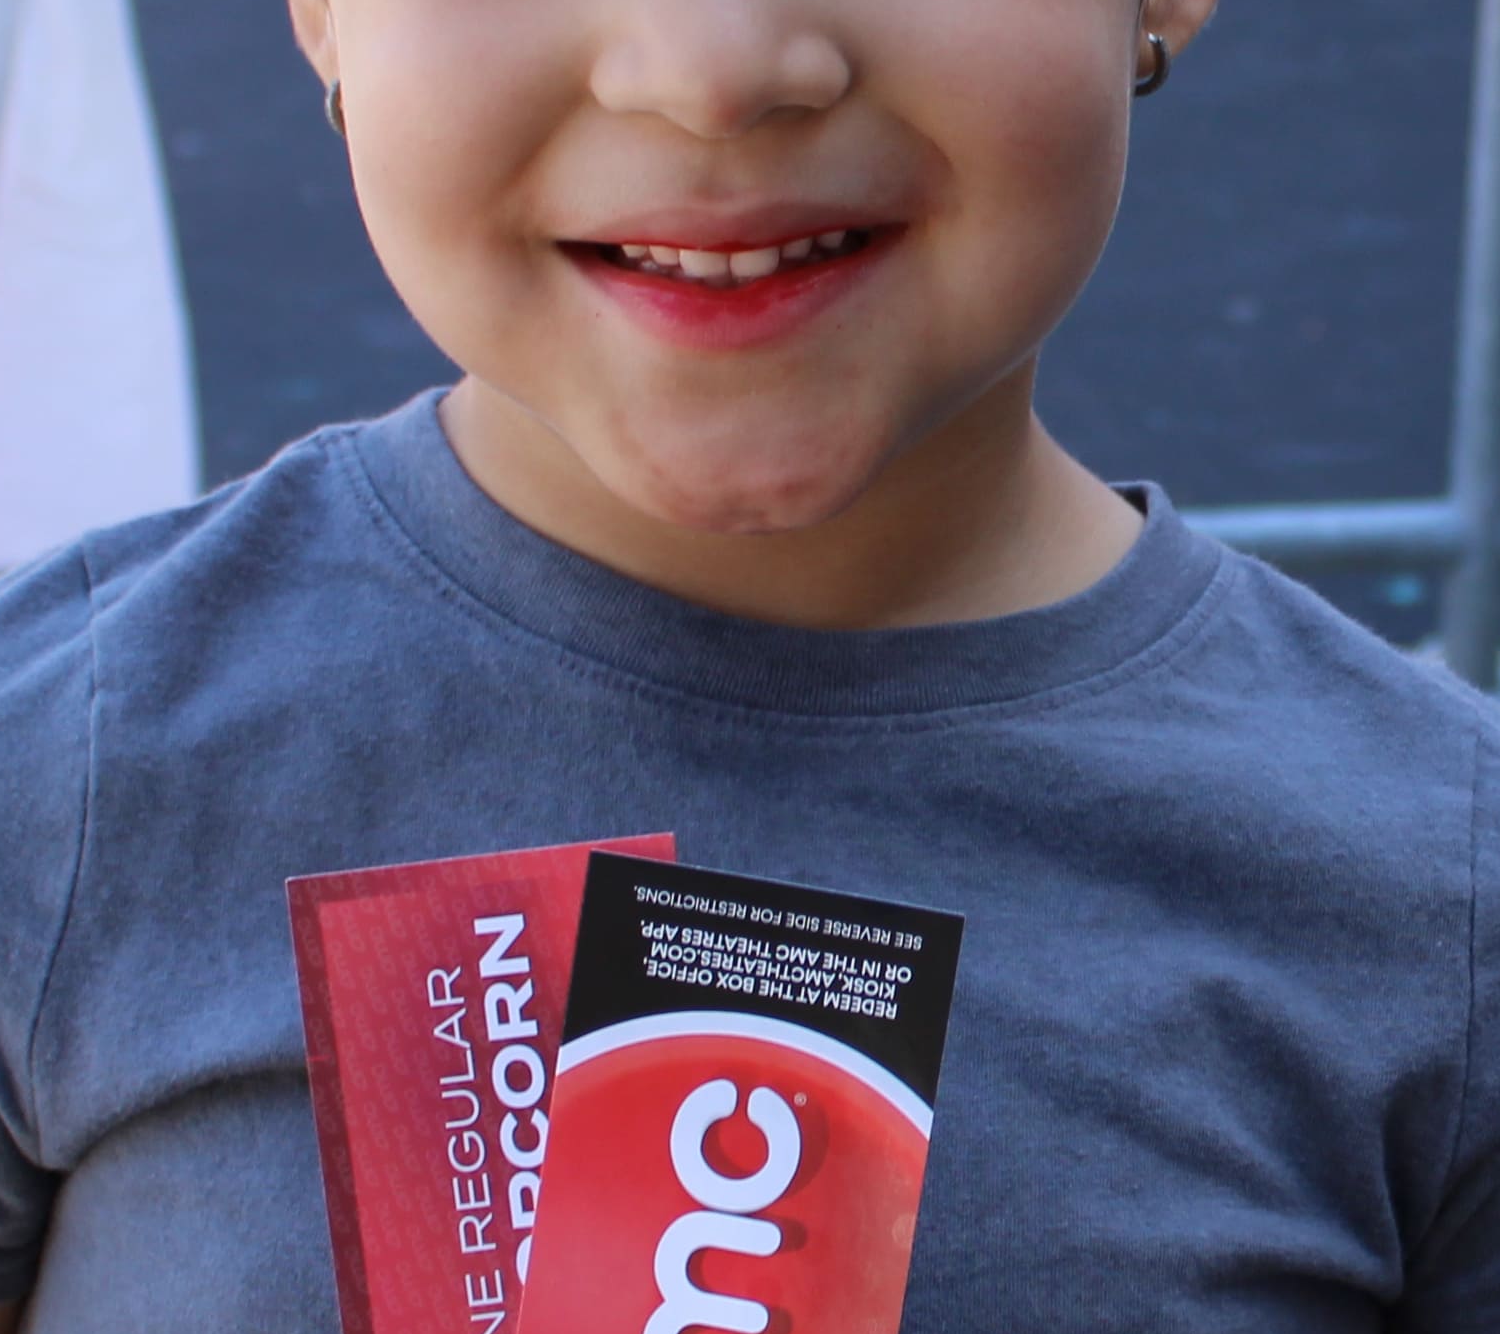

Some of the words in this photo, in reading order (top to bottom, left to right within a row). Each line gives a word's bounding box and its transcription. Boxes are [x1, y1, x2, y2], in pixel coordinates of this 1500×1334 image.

[633, 885, 747, 919] RESTRICTIONS.
[750, 906, 782, 926] FOR
[785, 912, 820, 933] SIDE
[640, 919, 679, 940] APP.
[823, 919, 892, 946] REVERSE
[894, 931, 924, 952] SEE
[681, 927, 772, 958] THEATRES
[650, 941, 835, 989] AMCTHEATRES.COM
[775, 943, 820, 968] AMC
[822, 953, 858, 975] THE
[643, 956, 713, 985] OFFICE,
[861, 960, 882, 978] IN
[885, 965, 912, 984] OR
[715, 971, 755, 993] BOX
[759, 980, 794, 1003] THE
[838, 971, 896, 1000] KIOSK,
[796, 986, 821, 1005] AT
[824, 990, 898, 1020] REDEEM
[425, 964, 498, 1255] REGULAR
[473, 912, 551, 1287] PCORN
